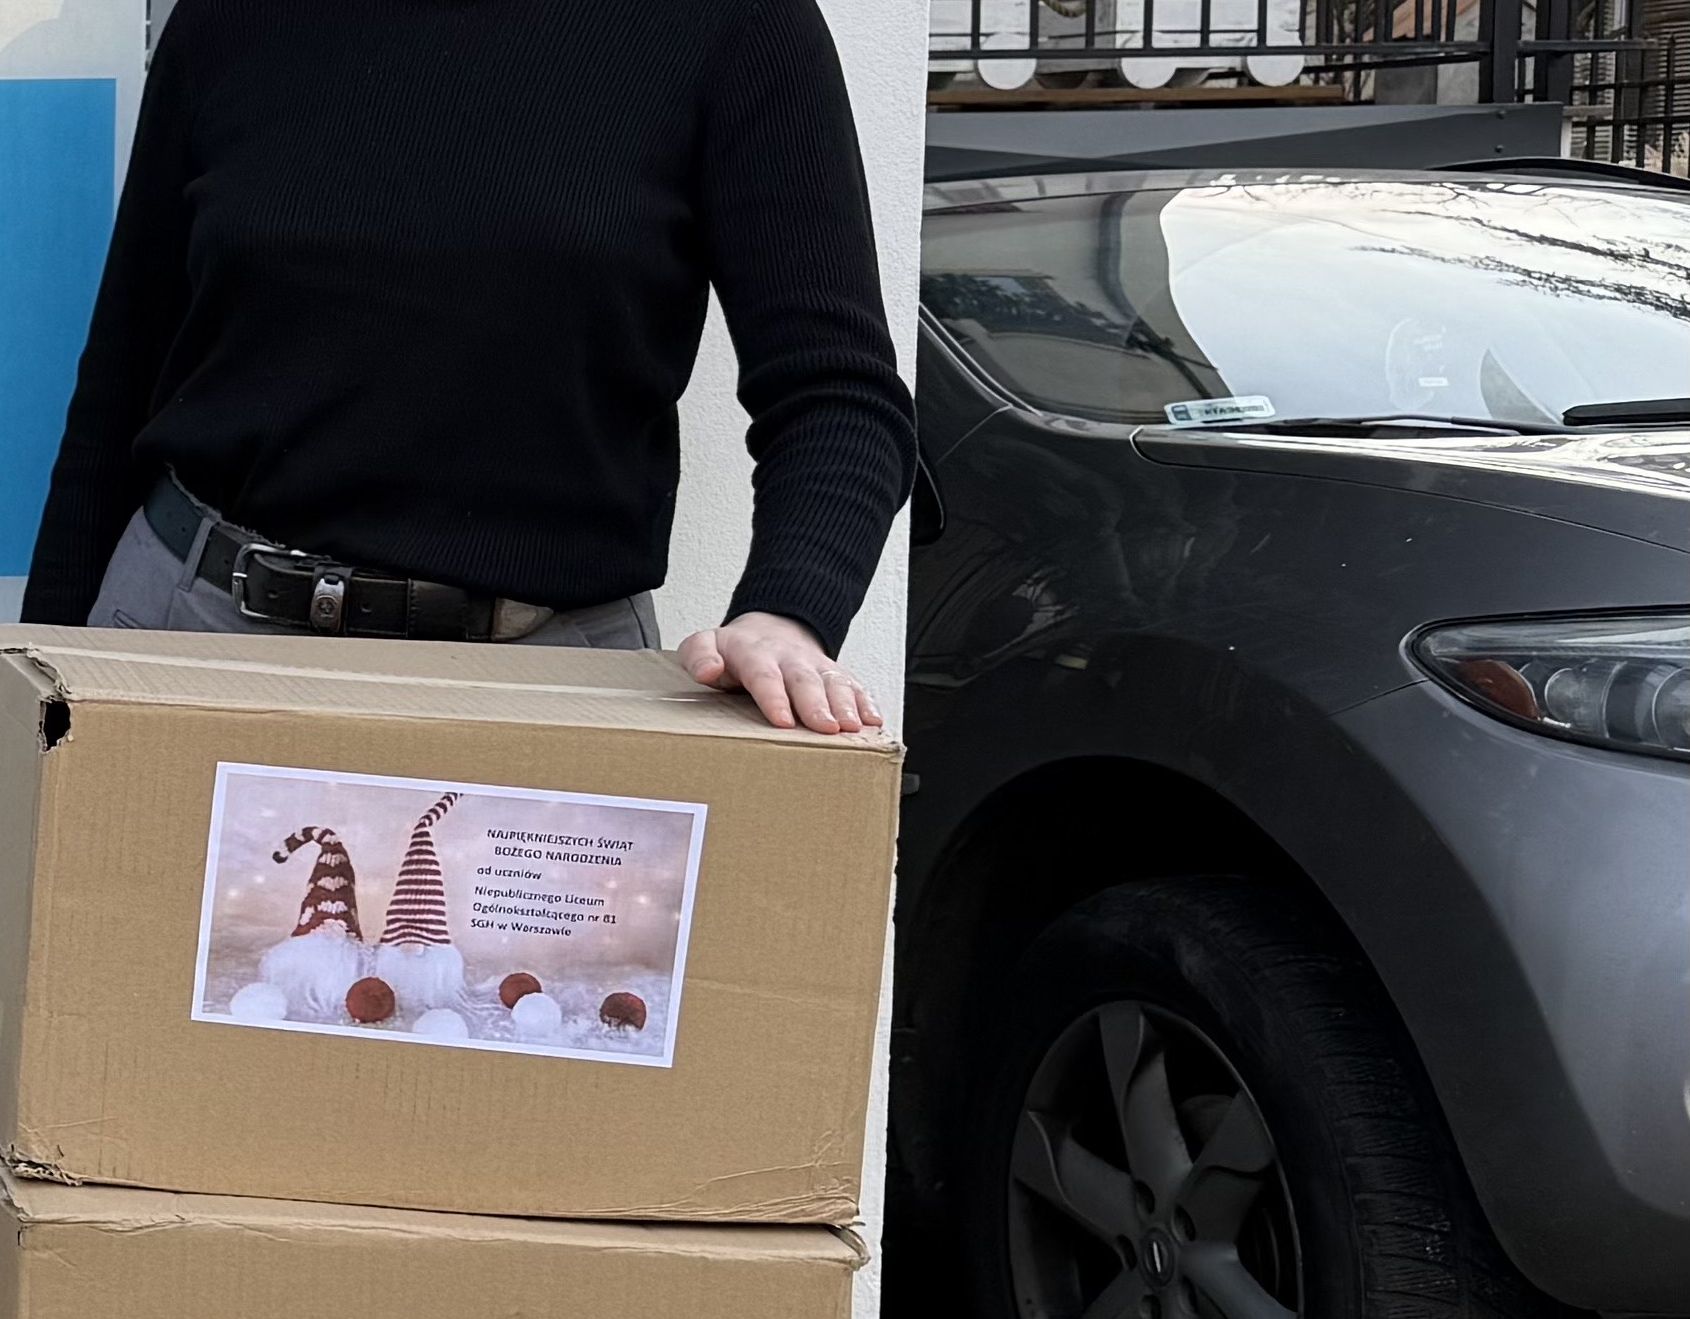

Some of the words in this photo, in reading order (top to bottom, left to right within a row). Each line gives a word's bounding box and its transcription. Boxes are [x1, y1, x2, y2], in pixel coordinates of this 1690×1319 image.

[487, 829, 594, 848] NAJPIĘKNIEJSZYCH
[596, 836, 634, 852] ŚWIĄT
[494, 845, 542, 860] BOŻEGO
[545, 852, 622, 866] NARODZENIA
[477, 866, 491, 876] od
[494, 868, 542, 880] uczniów
[474, 886, 562, 904] Niepublicznego
[564, 894, 605, 907] Liceum
[472, 902, 584, 923] Ogólnokształcącego
[587, 912, 600, 922] nr
[470, 918, 494, 929] SGH
[497, 921, 508, 931] w
[511, 922, 572, 937] Warszawie
